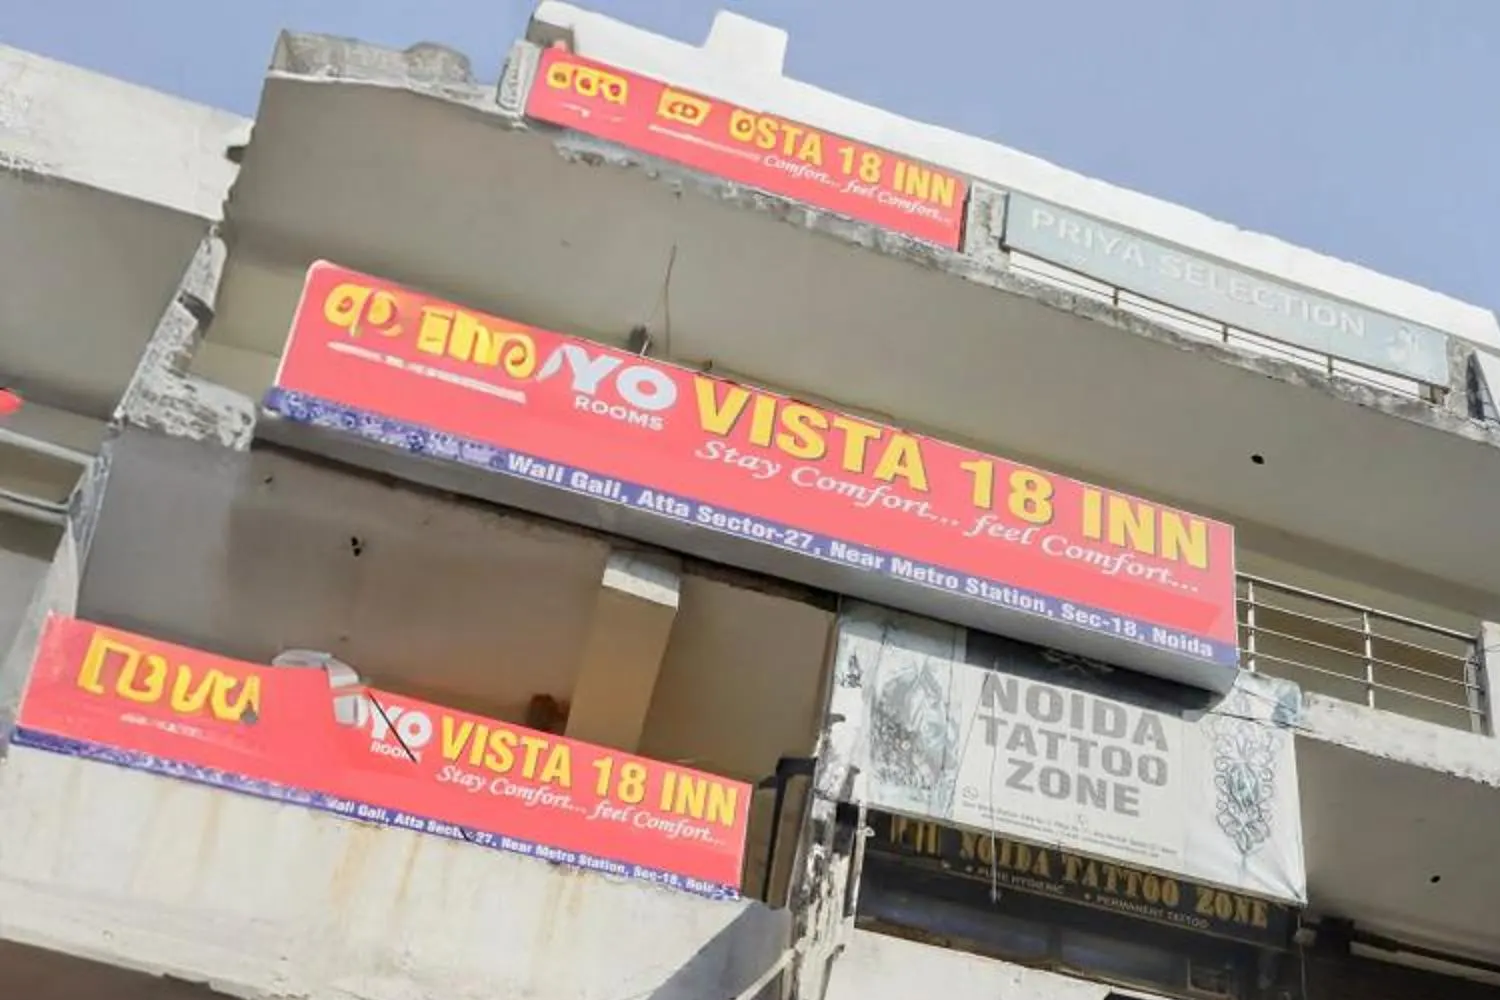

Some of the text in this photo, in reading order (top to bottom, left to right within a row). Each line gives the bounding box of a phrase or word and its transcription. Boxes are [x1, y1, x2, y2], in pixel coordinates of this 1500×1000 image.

[839, 147, 881, 184] 18
[894, 161, 956, 207] INN
[1031, 208, 1366, 337] PRIYA SELECTION
[574, 394, 664, 431] ROOMS
[693, 375, 1209, 569] VISTA 18 INN
[694, 440, 780, 479] Stay
[963, 515, 1039, 546] feel
[507, 453, 564, 484] Wall
[638, 488, 691, 518] Atta
[830, 541, 884, 569] Near
[891, 557, 959, 589] Metro
[1152, 627, 1213, 657] Noida
[977, 715, 1168, 787] TATTOO
[980, 671, 1170, 752] NOIDA
[435, 764, 487, 793] Stay
[588, 800, 631, 822] feel
[440, 715, 739, 826] VISTA 18 INN
[1004, 757, 1142, 817] ZONE
[535, 844, 575, 864] Metro
[960, 830, 1052, 877] NOIDA
[1060, 850, 1180, 907] TATTOO
[1196, 887, 1268, 929] ZONE
